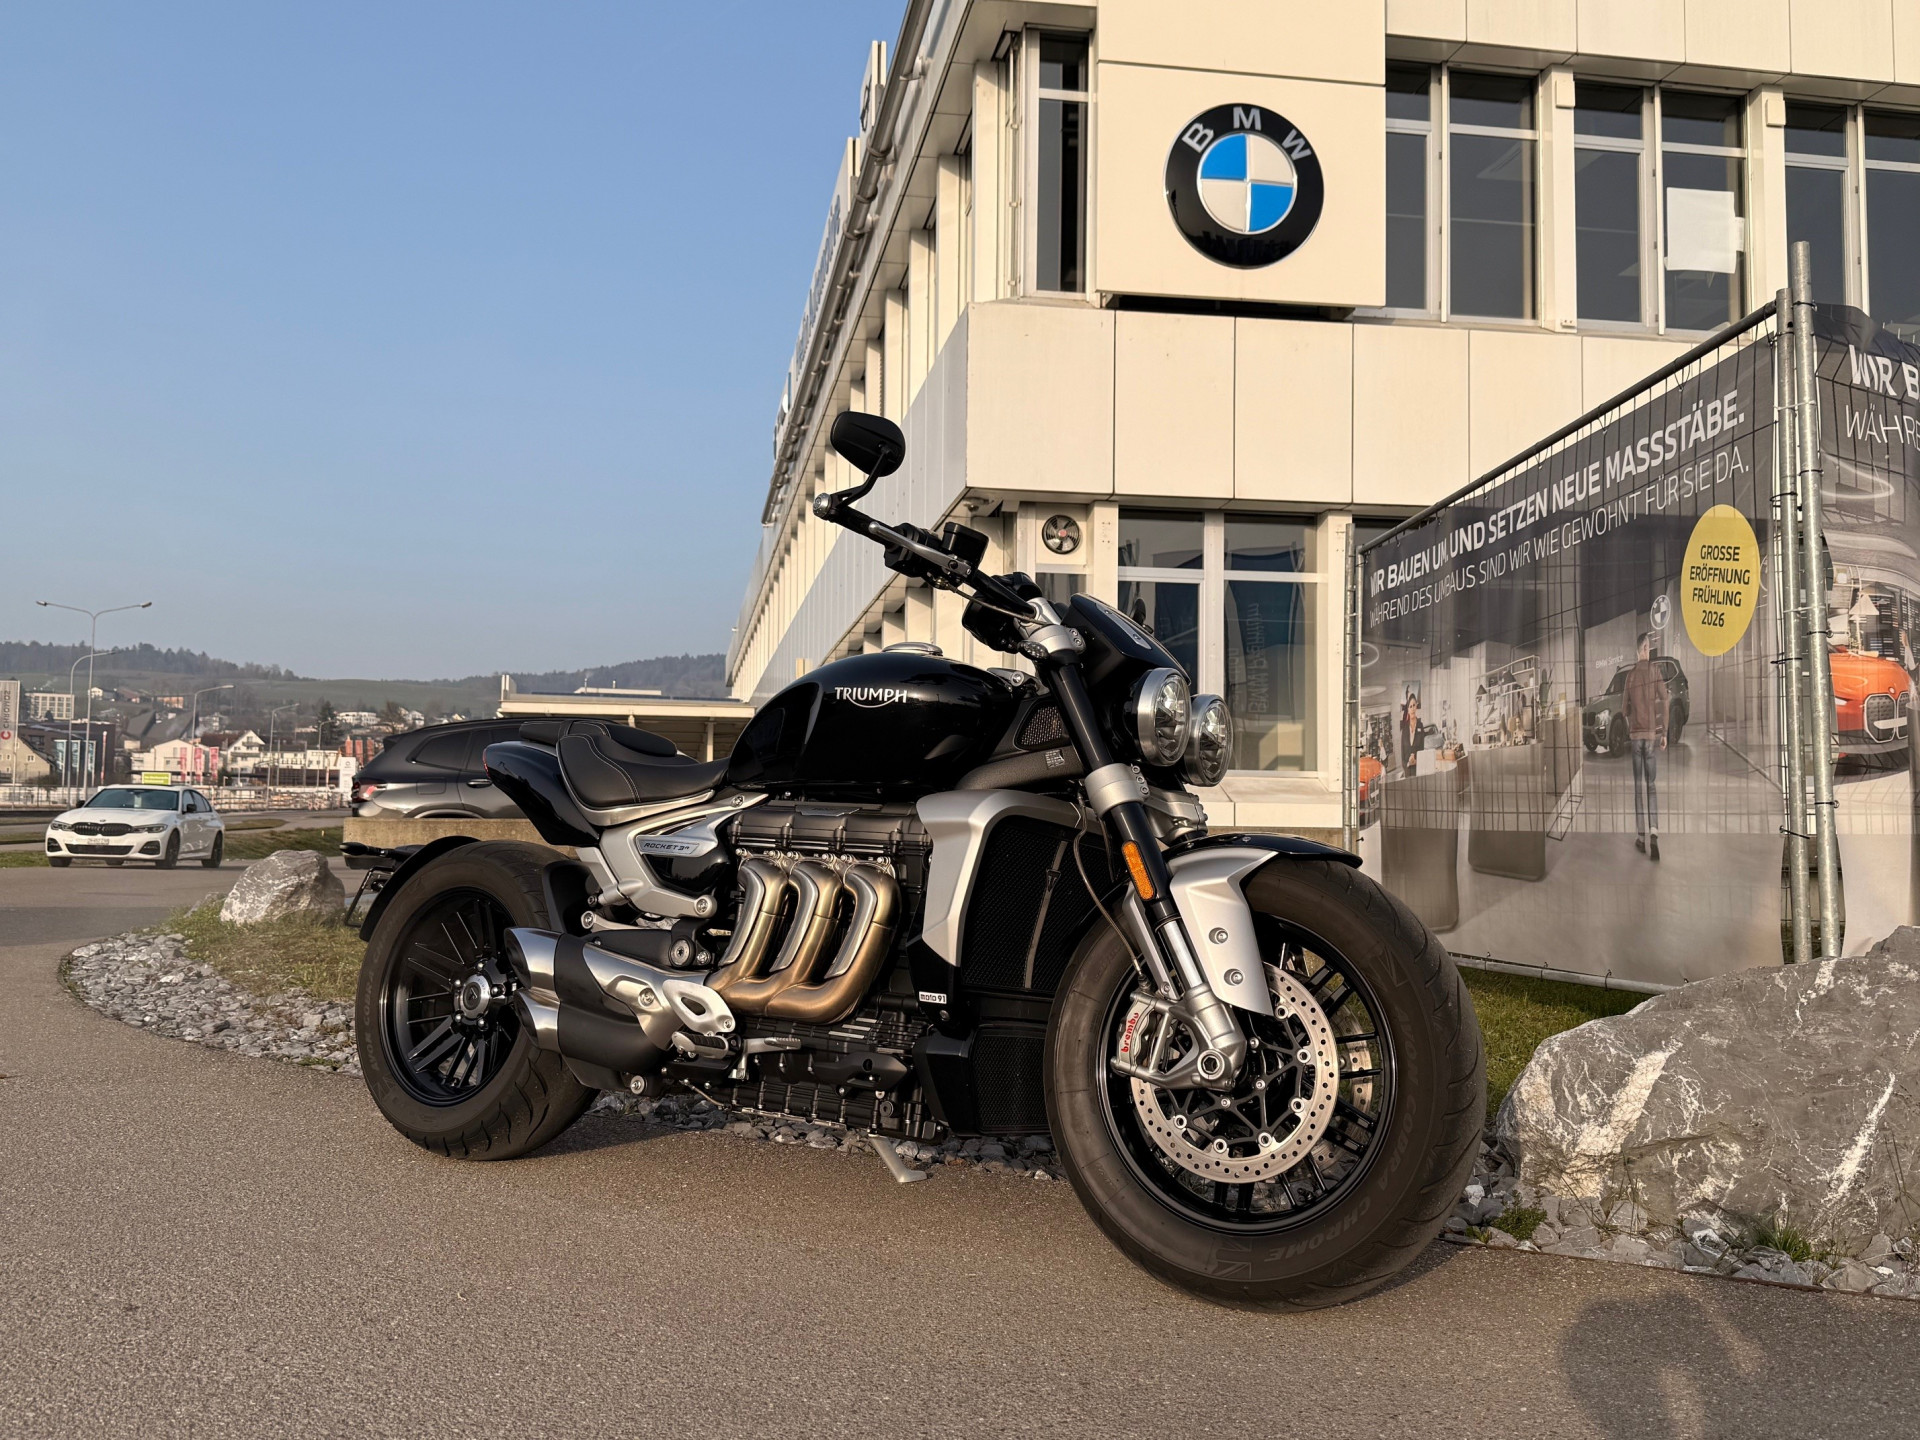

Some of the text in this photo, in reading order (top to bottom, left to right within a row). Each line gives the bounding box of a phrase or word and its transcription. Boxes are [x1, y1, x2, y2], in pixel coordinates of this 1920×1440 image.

[1182, 105, 1312, 162] BMW
[1848, 344, 1897, 396] WIR
[1370, 569, 1385, 598] WIR
[1387, 549, 1430, 589] BAUEN
[1450, 521, 1486, 559] UND
[1488, 488, 1548, 544] SETZEN
[1553, 461, 1600, 514] NEUE
[1605, 389, 1745, 489] MASSSTÄBE.
[1369, 593, 1410, 629] WÄHREND
[1411, 584, 1432, 612] DES
[1479, 552, 1507, 585] SIND
[1509, 541, 1531, 572] WIR
[1533, 527, 1560, 562] WIE
[1561, 490, 1642, 549] GEWOHNT
[1645, 473, 1679, 516] FÜR
[1684, 458, 1711, 499] SIE
[1716, 445, 1750, 485] DA.
[1700, 544, 1740, 562] GROSSE
[1689, 563, 1750, 585] ERÖFFNUNG
[1692, 585, 1742, 607] FRÜHLING
[1701, 609, 1725, 628] 2026
[835, 686, 907, 708] TRIUMPH
[938, 994, 946, 1003] 91
[1121, 1012, 1139, 1053] brembo
[1264, 1005, 1419, 1263] AVON COBRA CHROME
